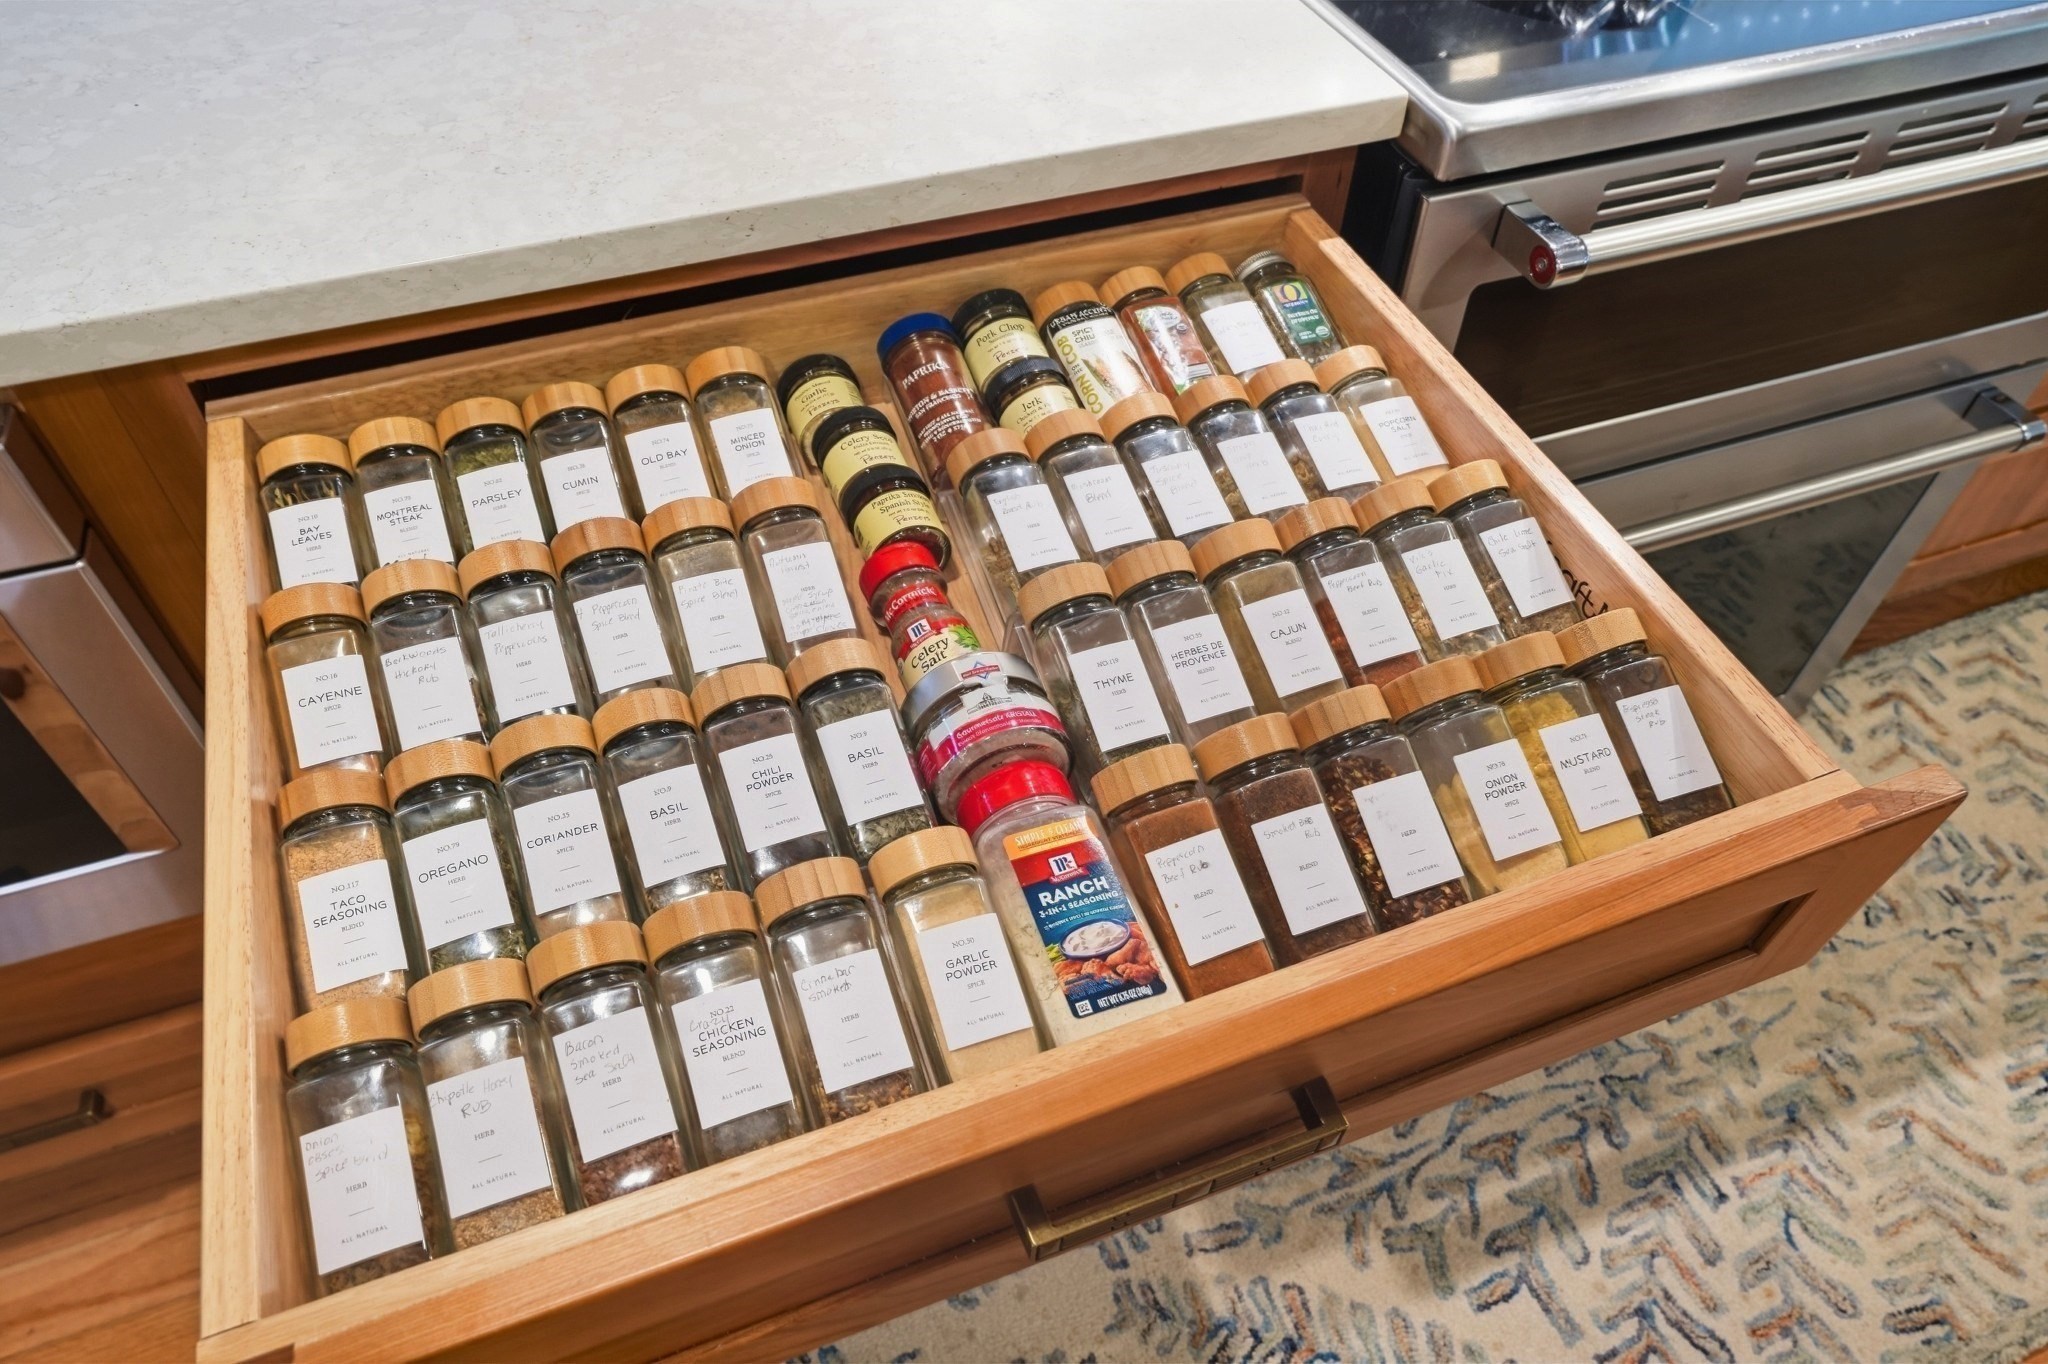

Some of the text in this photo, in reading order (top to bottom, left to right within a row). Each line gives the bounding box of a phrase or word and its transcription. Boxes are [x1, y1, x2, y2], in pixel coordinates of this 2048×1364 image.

[1049, 312, 1078, 329] URBAN
[976, 330, 997, 347] Pork
[998, 323, 1025, 334] Chop
[902, 360, 950, 389] PAPRIKA
[1022, 397, 1043, 412] Jerk
[1378, 416, 1417, 428] POPCORN
[1391, 424, 1411, 432] SALT
[730, 431, 765, 445] MINCED
[735, 439, 765, 452] ONION
[840, 435, 870, 451] Celery
[641, 448, 688, 467] OLD BAY
[562, 475, 599, 491] CUMIN
[471, 489, 523, 508] PARSLEY
[871, 491, 901, 509] Paprika
[377, 503, 432, 521] MONTREAL
[389, 513, 423, 527] STEAK
[291, 531, 332, 546] LEAVES
[299, 525, 321, 537] BAY
[1270, 622, 1307, 640] CAJUN
[911, 637, 949, 669] Celery
[1170, 640, 1224, 661] HERBES DE
[1175, 649, 1227, 669] PROVENCE
[920, 650, 948, 673] Salt
[1093, 672, 1135, 690] THYME
[298, 686, 363, 708] CAYENNE
[847, 746, 885, 763] BASIL
[1560, 747, 1611, 769] MUSTARD
[751, 765, 782, 780] CHILI
[1486, 773, 1518, 789] ONION
[746, 772, 794, 793] POWDER
[1485, 782, 1527, 801] POWDER
[650, 802, 689, 820] BASIL
[526, 823, 598, 849] CORIANDER
[418, 854, 489, 884] OREGANO
[1038, 876, 1110, 906] RANCH
[1068, 890, 1119, 909] SEASONING
[330, 894, 366, 911] TACO
[313, 900, 387, 929] SEASONING
[945, 949, 990, 970] GARLIC
[945, 960, 998, 982] POWDER
[698, 1017, 754, 1042] CHICKEN
[564, 1035, 604, 1057] Bacon
[692, 1026, 767, 1058] SEASONING
[474, 1129, 495, 1141] HERB
[345, 1181, 367, 1194] HERB
